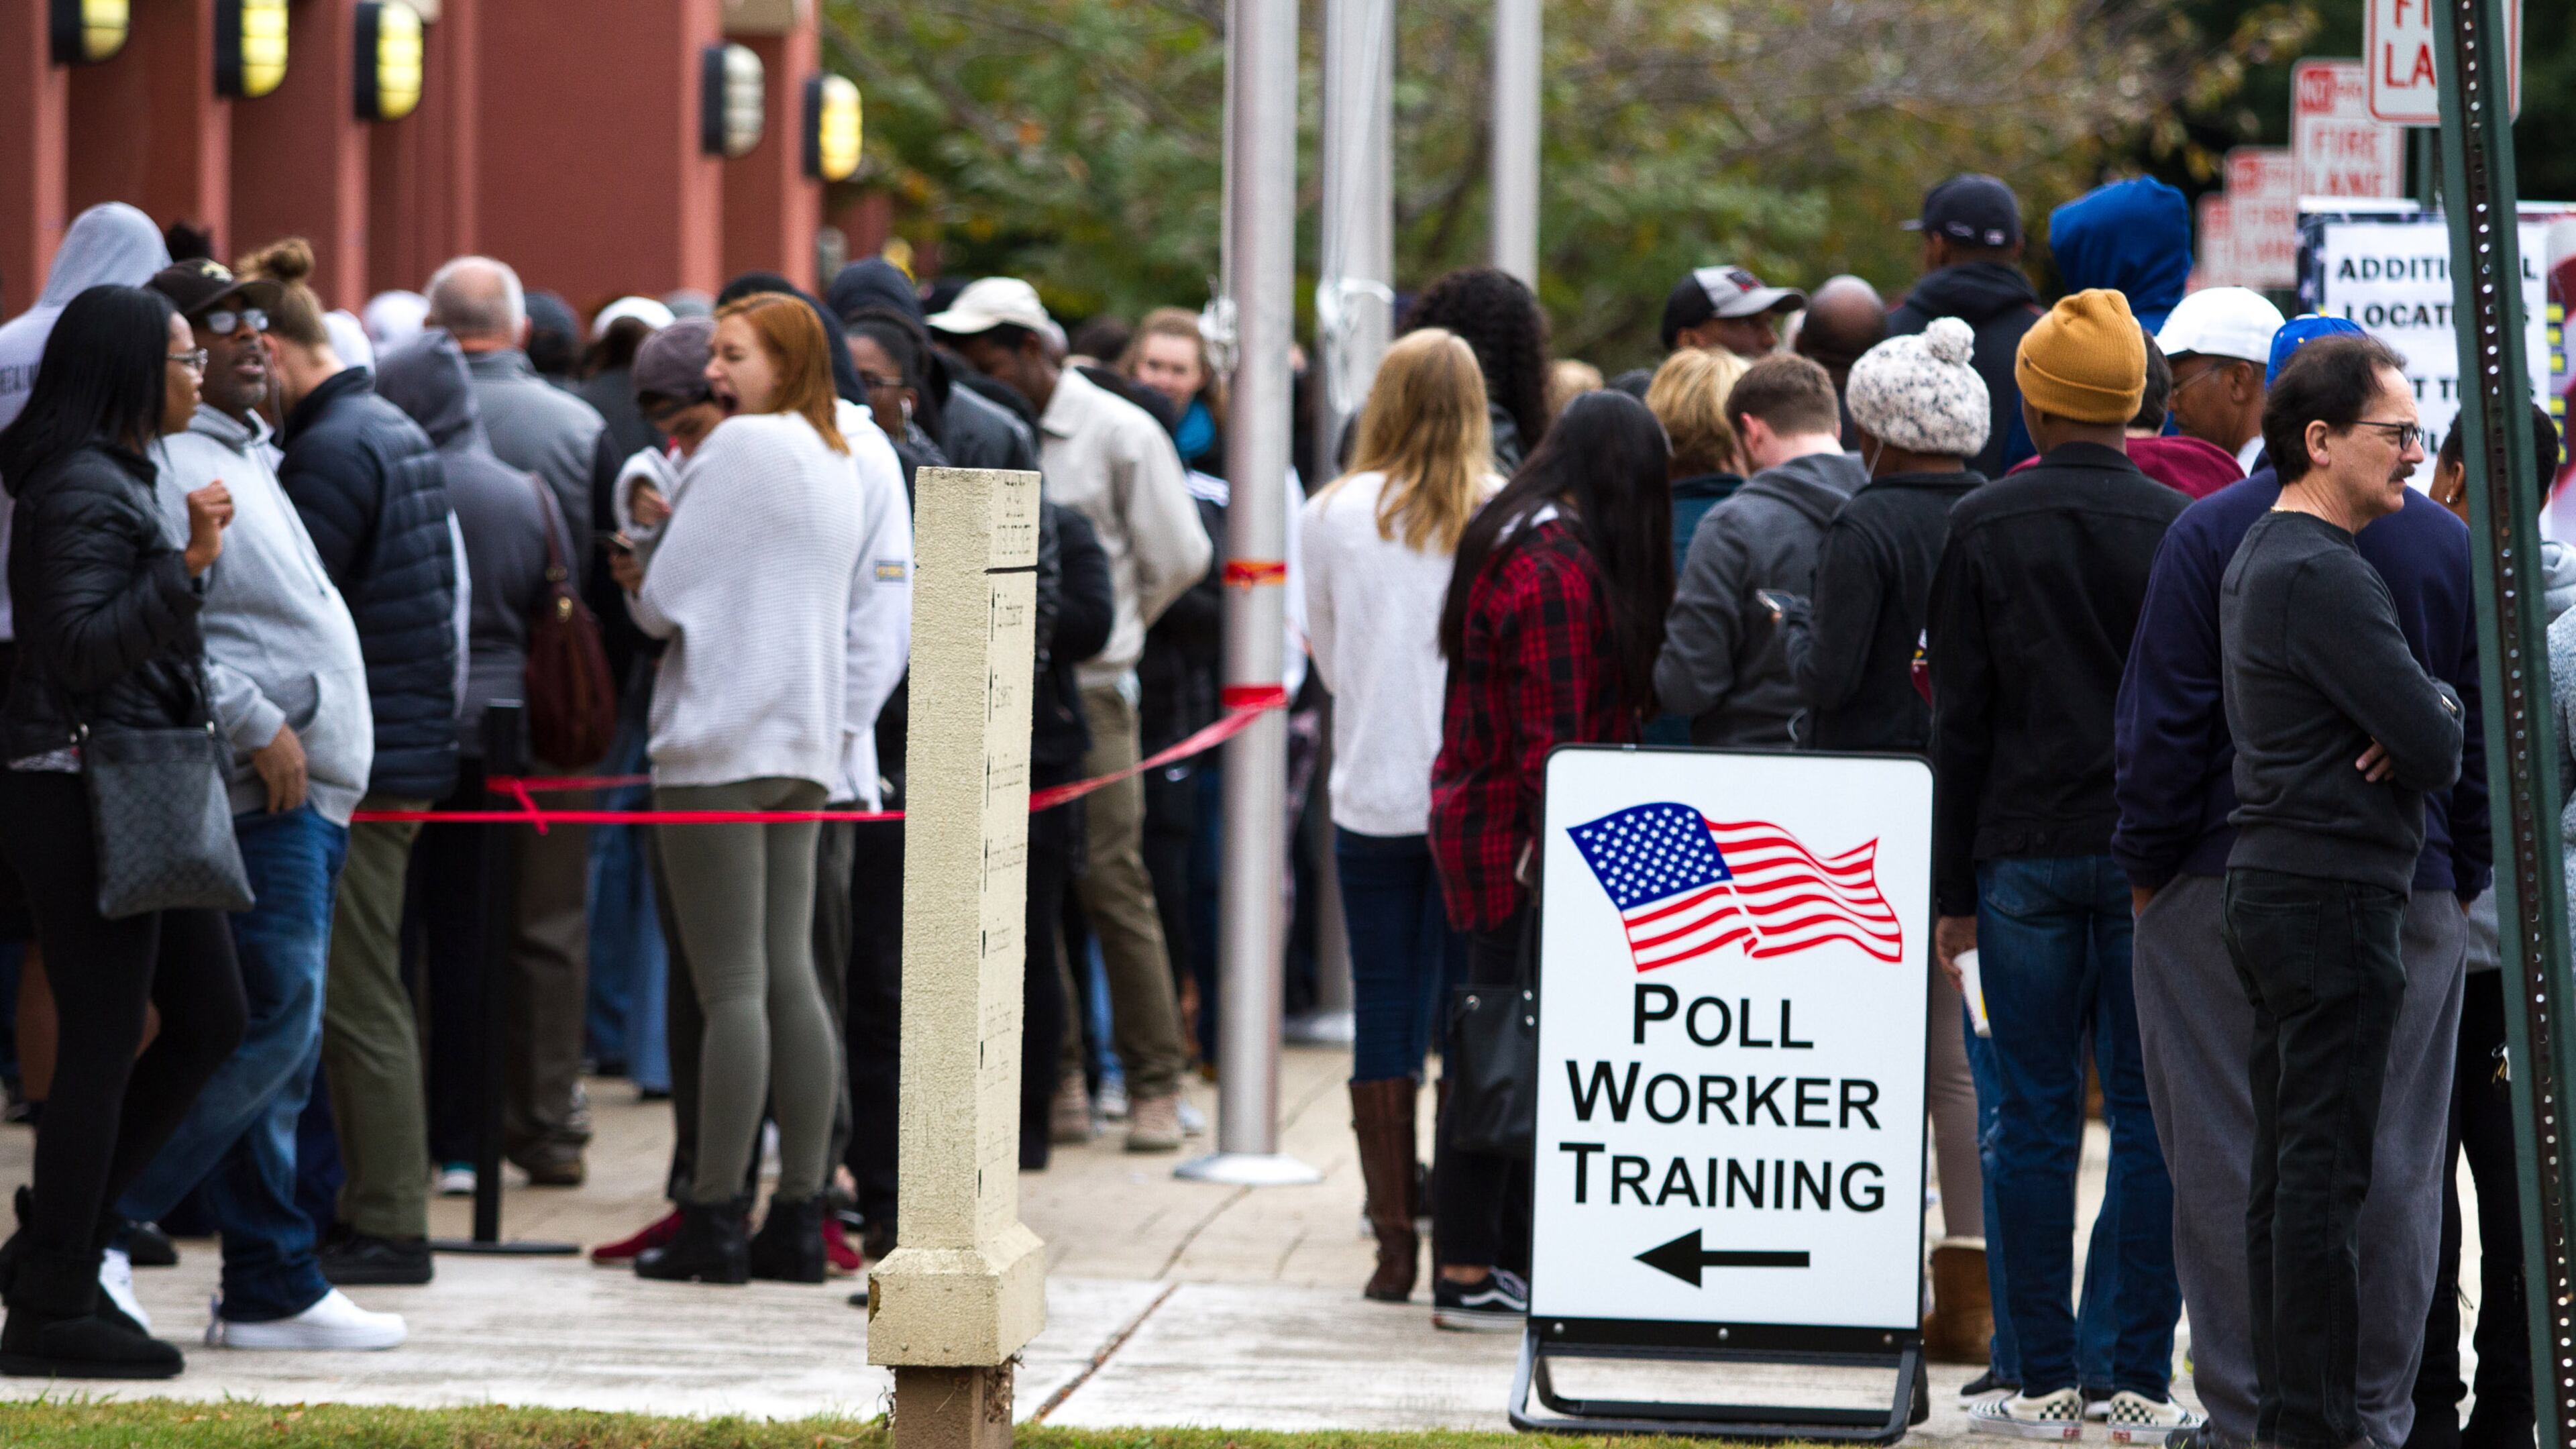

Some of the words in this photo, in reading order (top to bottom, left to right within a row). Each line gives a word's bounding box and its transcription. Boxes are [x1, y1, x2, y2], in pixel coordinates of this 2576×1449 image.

[2394, 0, 2430, 28] FI
[2384, 41, 2437, 89] LA
[2337, 257, 2539, 280] ADDITIL
[2345, 303, 2531, 328] LOCAT
[1633, 982, 1815, 1049] POLL
[1566, 1060, 1881, 1130] WORKER
[1558, 1142, 1885, 1213] TRAINING
